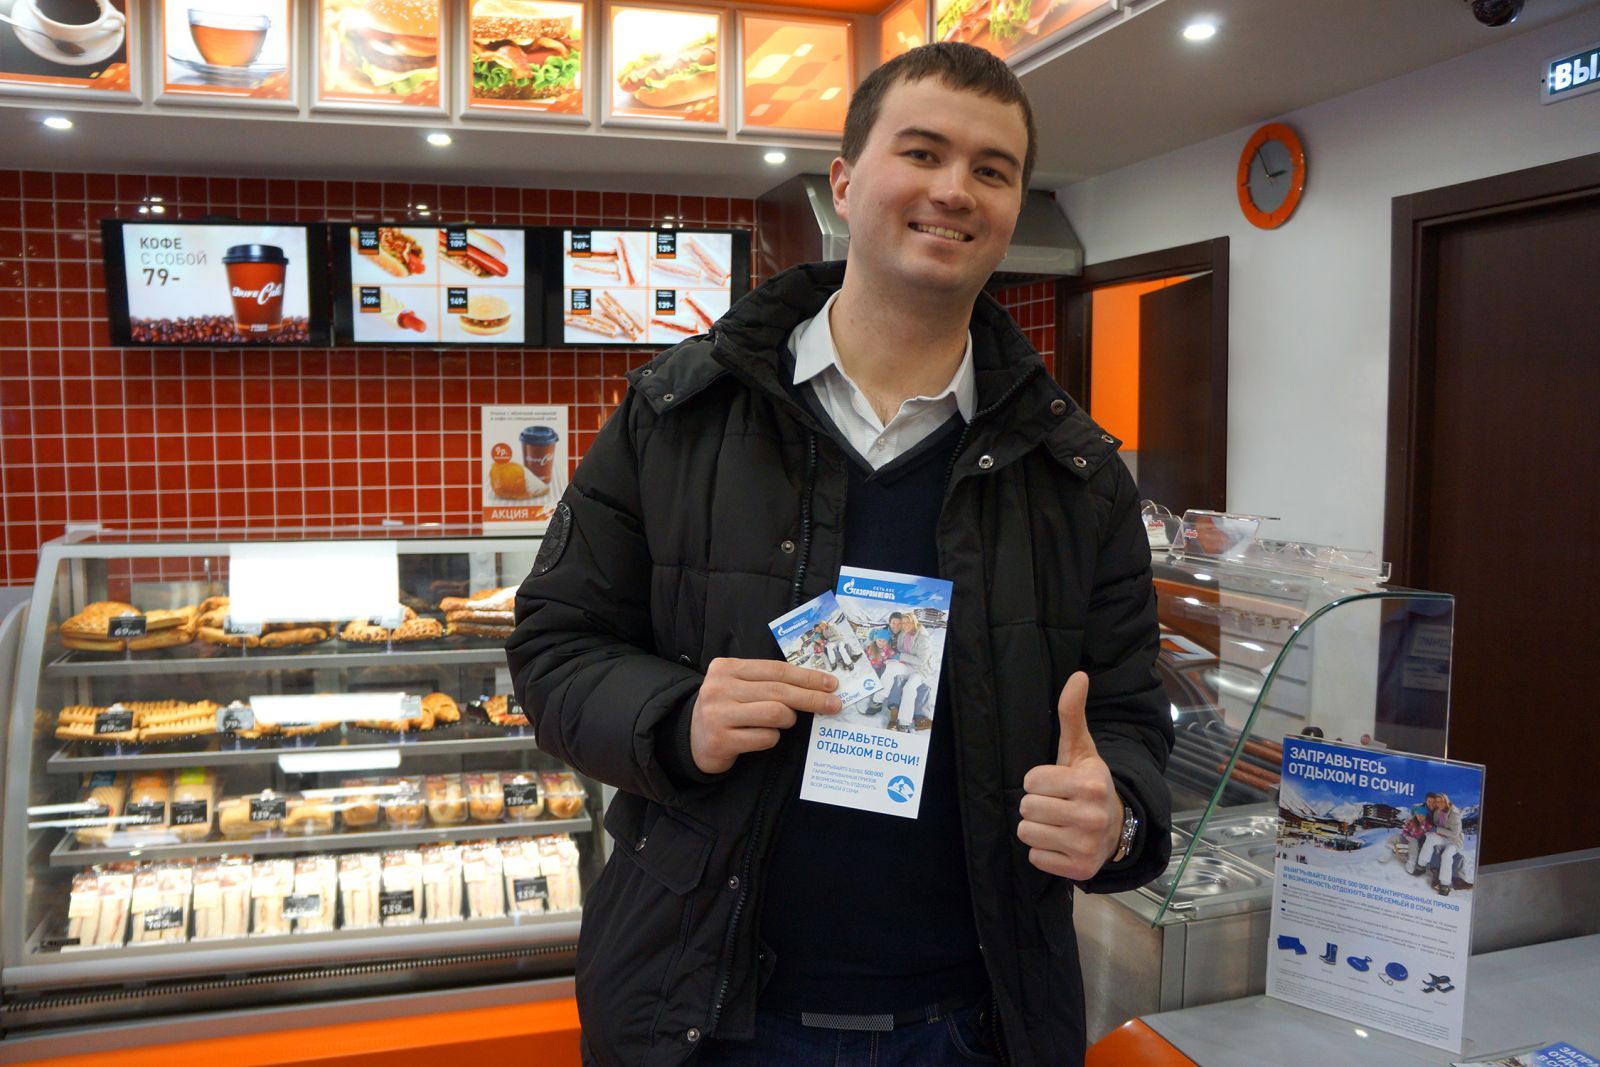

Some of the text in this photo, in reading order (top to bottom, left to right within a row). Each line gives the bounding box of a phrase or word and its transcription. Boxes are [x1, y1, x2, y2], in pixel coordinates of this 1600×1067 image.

[1554, 51, 1600, 91] ВЫ
[139, 237, 183, 250] КОФЕ
[140, 250, 208, 266] С СОБОЙ
[142, 268, 181, 287] 79-
[491, 508, 529, 520] АКЦИЯ
[818, 726, 899, 749] ЗАПРАВЬТЕСЬ
[816, 740, 920, 766] ОТДЫХОМ В СОЧИ!
[1289, 746, 1387, 775] ЗАПРАВЬТЕСЬ
[1288, 762, 1415, 797] ОТДЫХОМ В СОЧИ!
